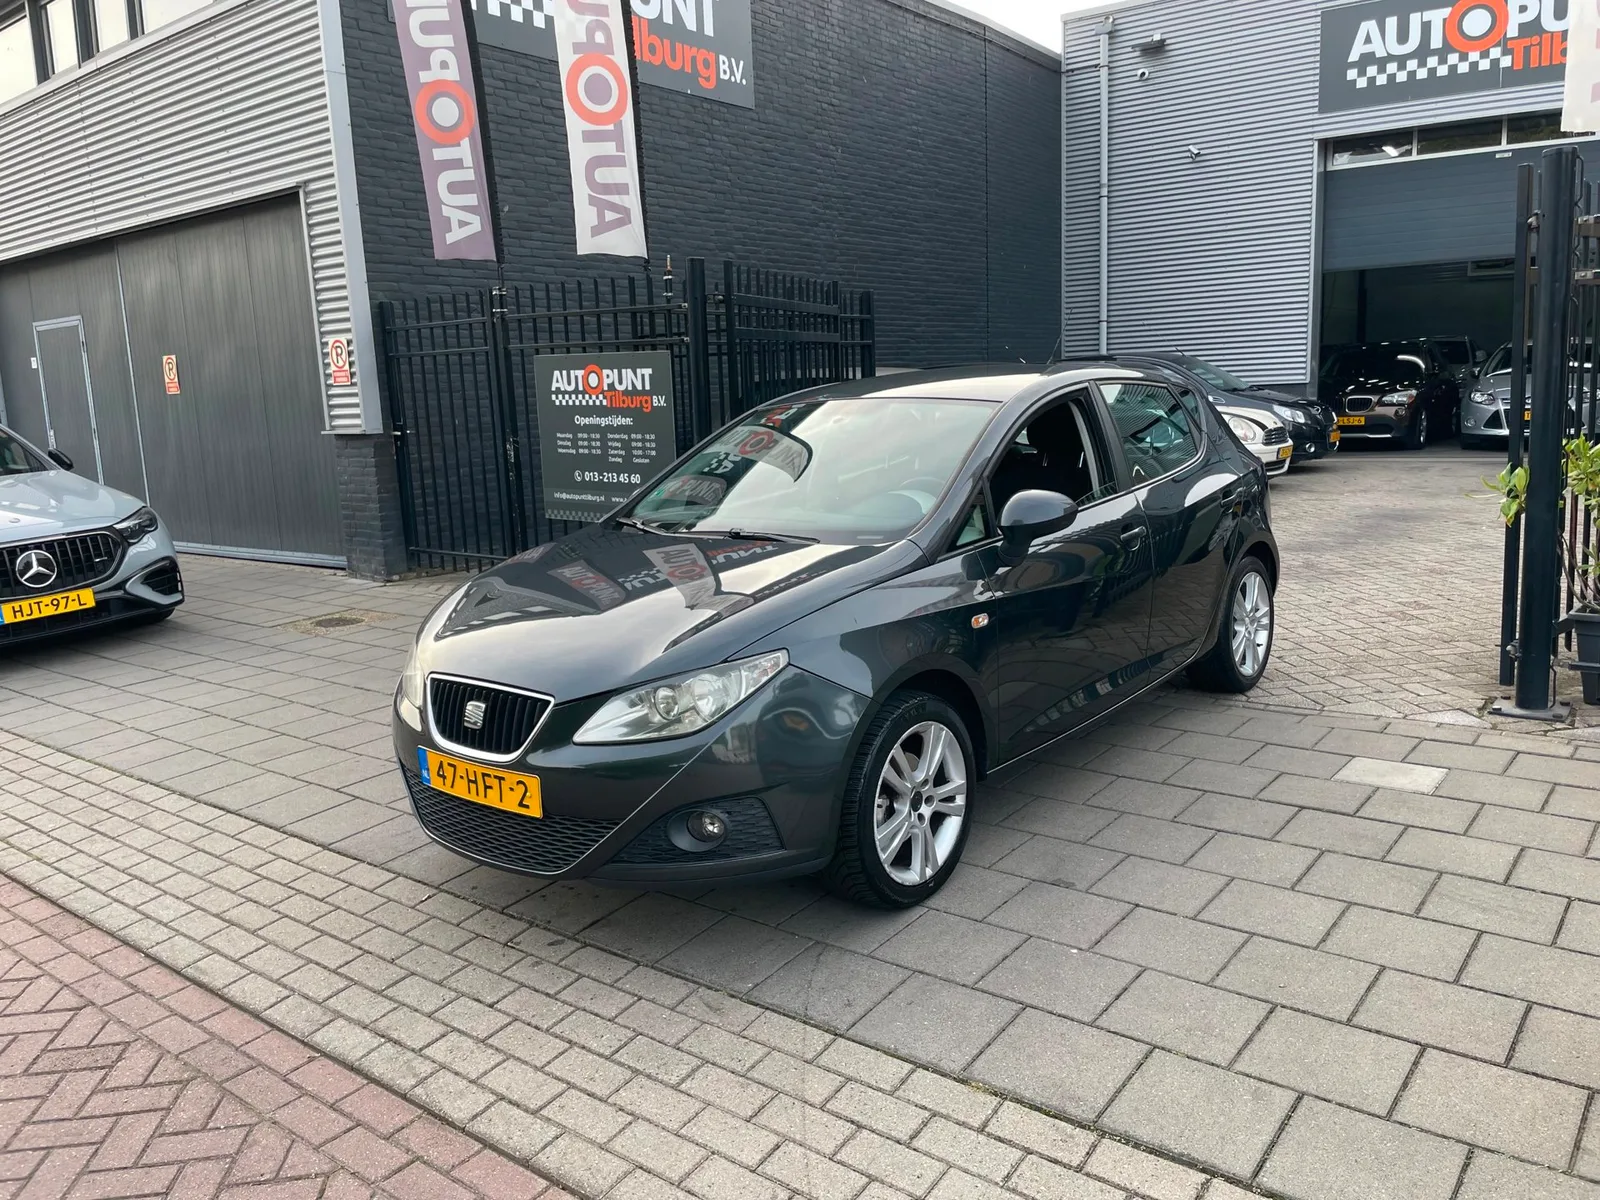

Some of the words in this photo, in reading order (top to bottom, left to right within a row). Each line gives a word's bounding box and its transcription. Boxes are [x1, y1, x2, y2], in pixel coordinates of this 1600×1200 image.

[719, 54, 747, 85] B.V.
[551, 364, 652, 396] AUTOPUNT
[604, 390, 652, 412] Tilburg
[652, 395, 667, 407] B.V.
[574, 414, 633, 427] Openingstijden:
[619, 473, 629, 484] 45
[630, 473, 641, 484] 60
[12, 594, 87, 619] HJT-97-L
[436, 760, 530, 809] 47-HFT-2
